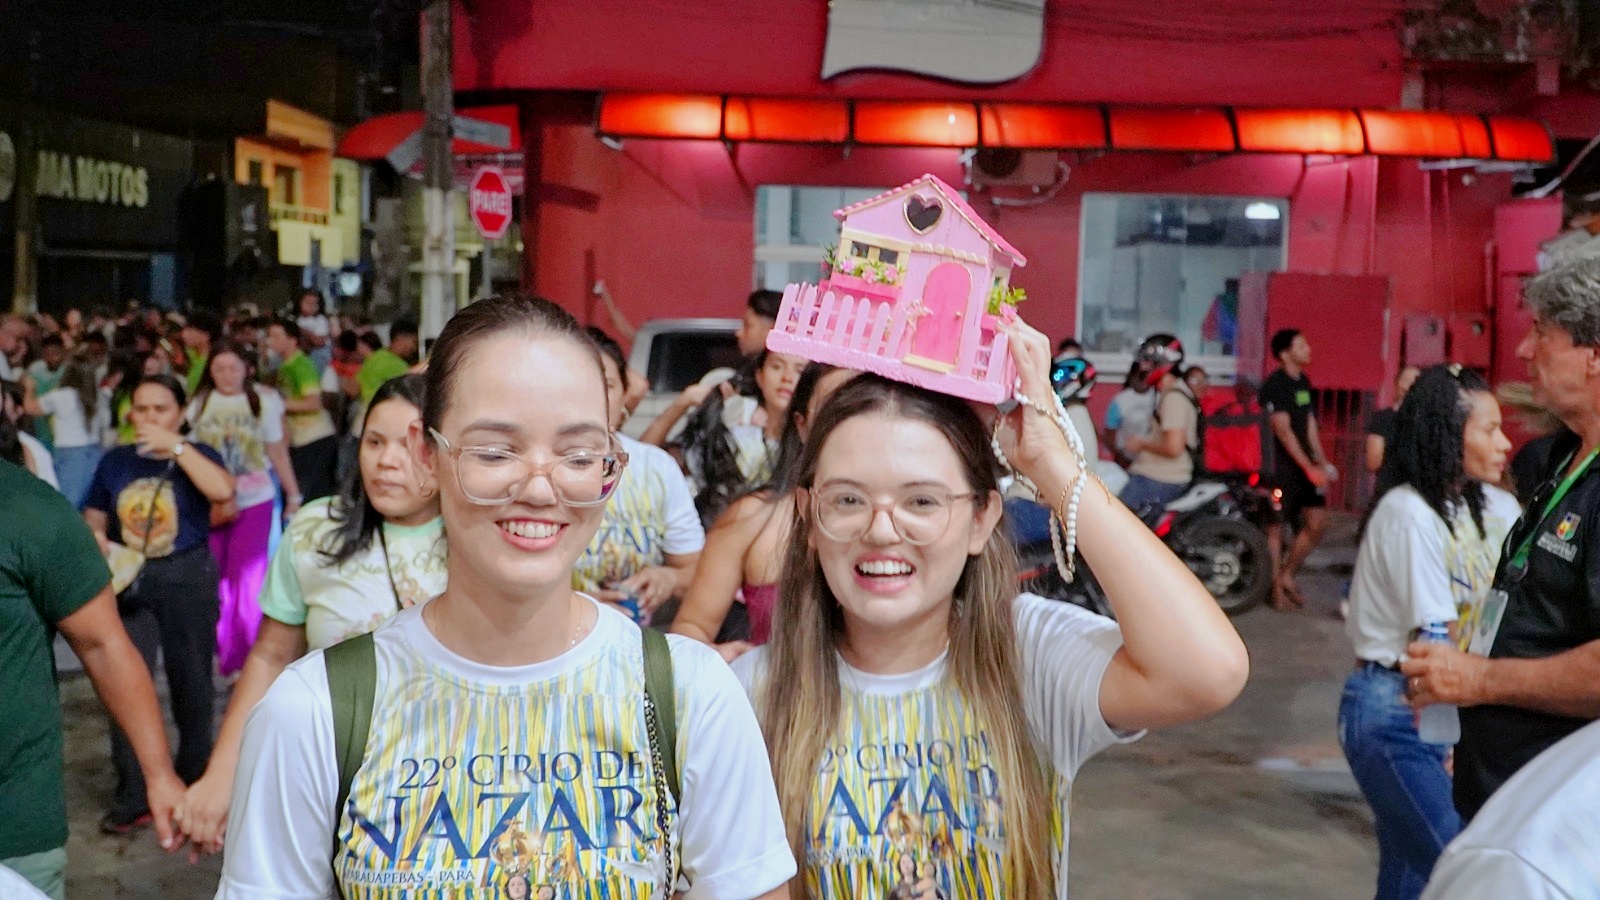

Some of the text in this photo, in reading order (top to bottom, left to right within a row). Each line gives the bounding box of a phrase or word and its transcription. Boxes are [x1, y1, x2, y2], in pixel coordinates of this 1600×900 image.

[76, 155, 149, 208] MOTOS
[474, 189, 508, 216] PARE
[467, 745, 582, 786] CÍRIO
[592, 750, 645, 780] DE
[438, 866, 475, 882] PARÁ
